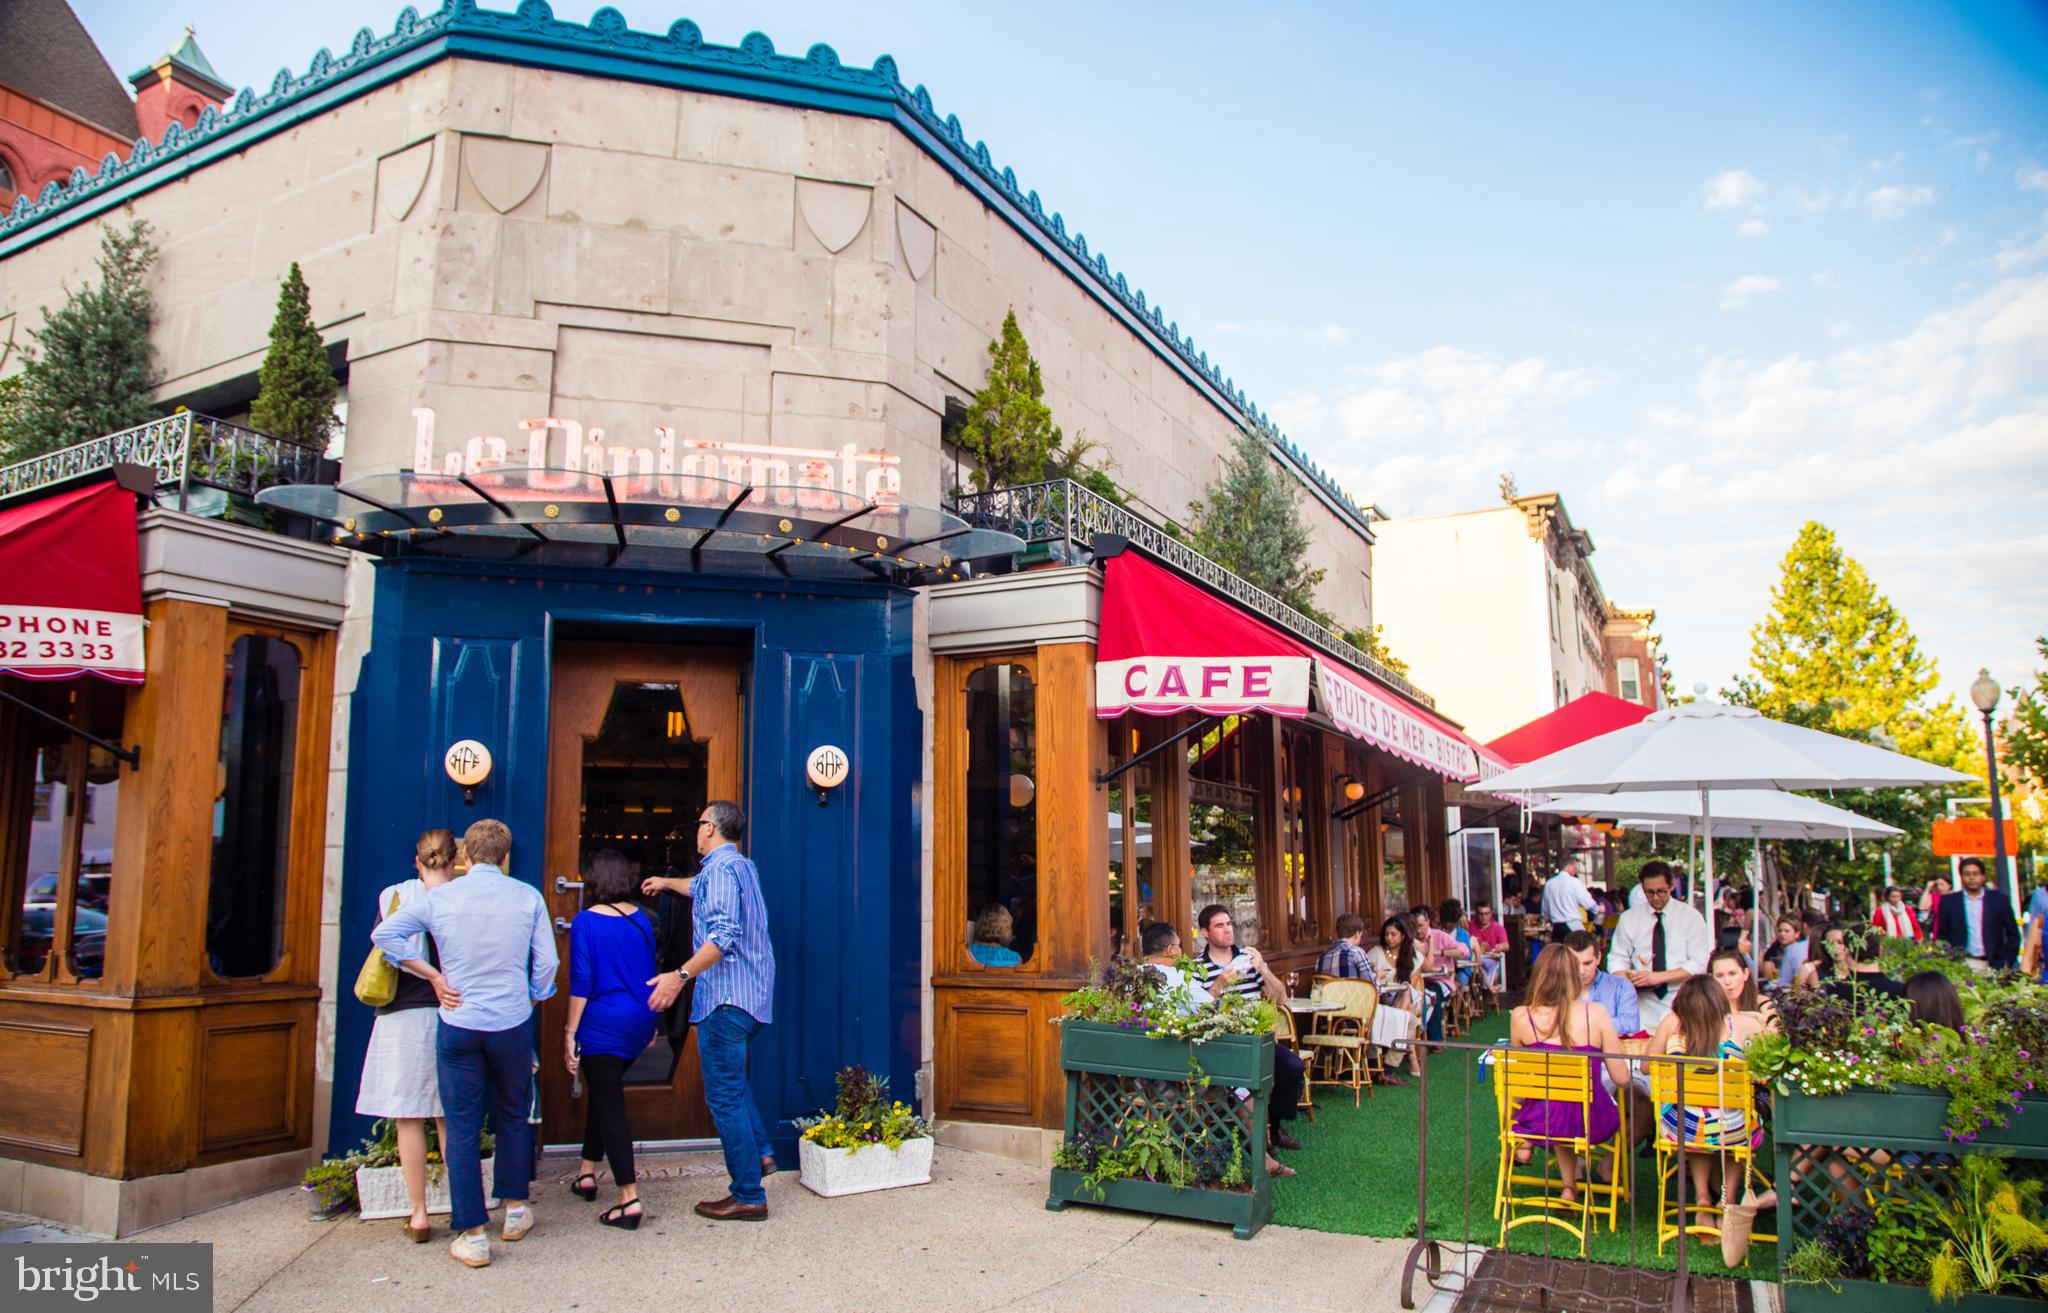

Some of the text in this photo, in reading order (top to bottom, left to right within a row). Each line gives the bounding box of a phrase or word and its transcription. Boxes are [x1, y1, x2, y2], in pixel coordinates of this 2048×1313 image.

[411, 407, 507, 484] Le
[40, 641, 114, 660] 3333
[1124, 664, 1273, 698] CAFE
[1324, 673, 1378, 732] FRUITS
[1382, 708, 1398, 741] DE
[1402, 719, 1426, 756] MER
[1436, 735, 1467, 772] BISTRO
